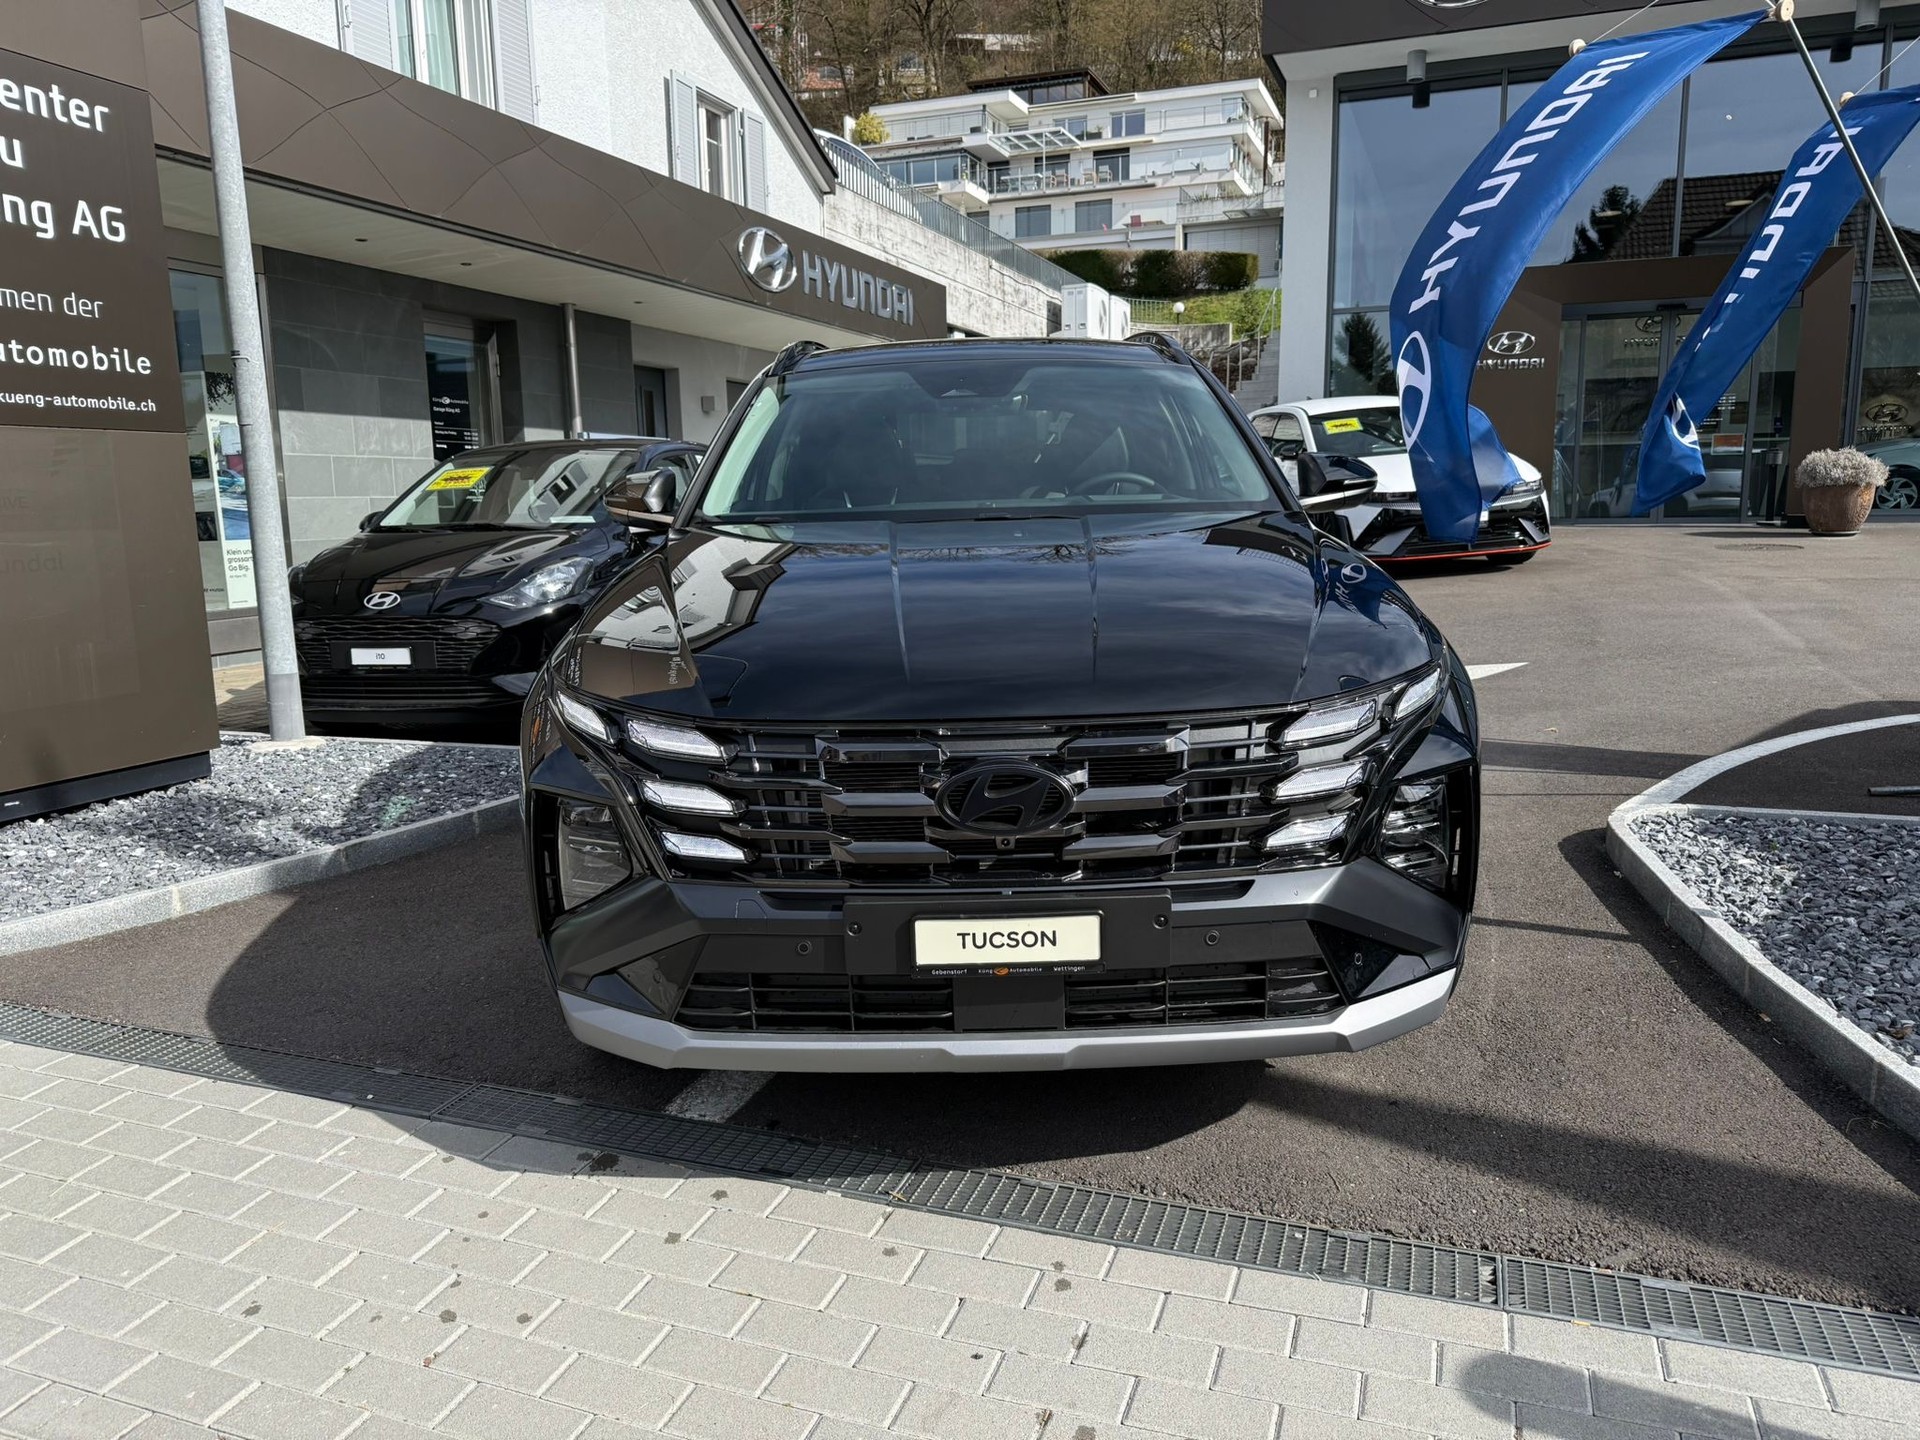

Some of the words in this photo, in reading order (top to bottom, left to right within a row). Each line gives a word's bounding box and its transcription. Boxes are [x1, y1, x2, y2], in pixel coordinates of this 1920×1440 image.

[0, 78, 110, 132] enter
[1409, 52, 1650, 314] HYUNDAI
[2, 193, 55, 240] ng
[72, 200, 126, 243] AG
[63, 292, 103, 318] der
[803, 250, 914, 326] HYUNDAI
[1476, 358, 1545, 370] HYUNDAI
[957, 930, 1057, 949] TUCSON
[1053, 965, 1085, 973] Wettingen
